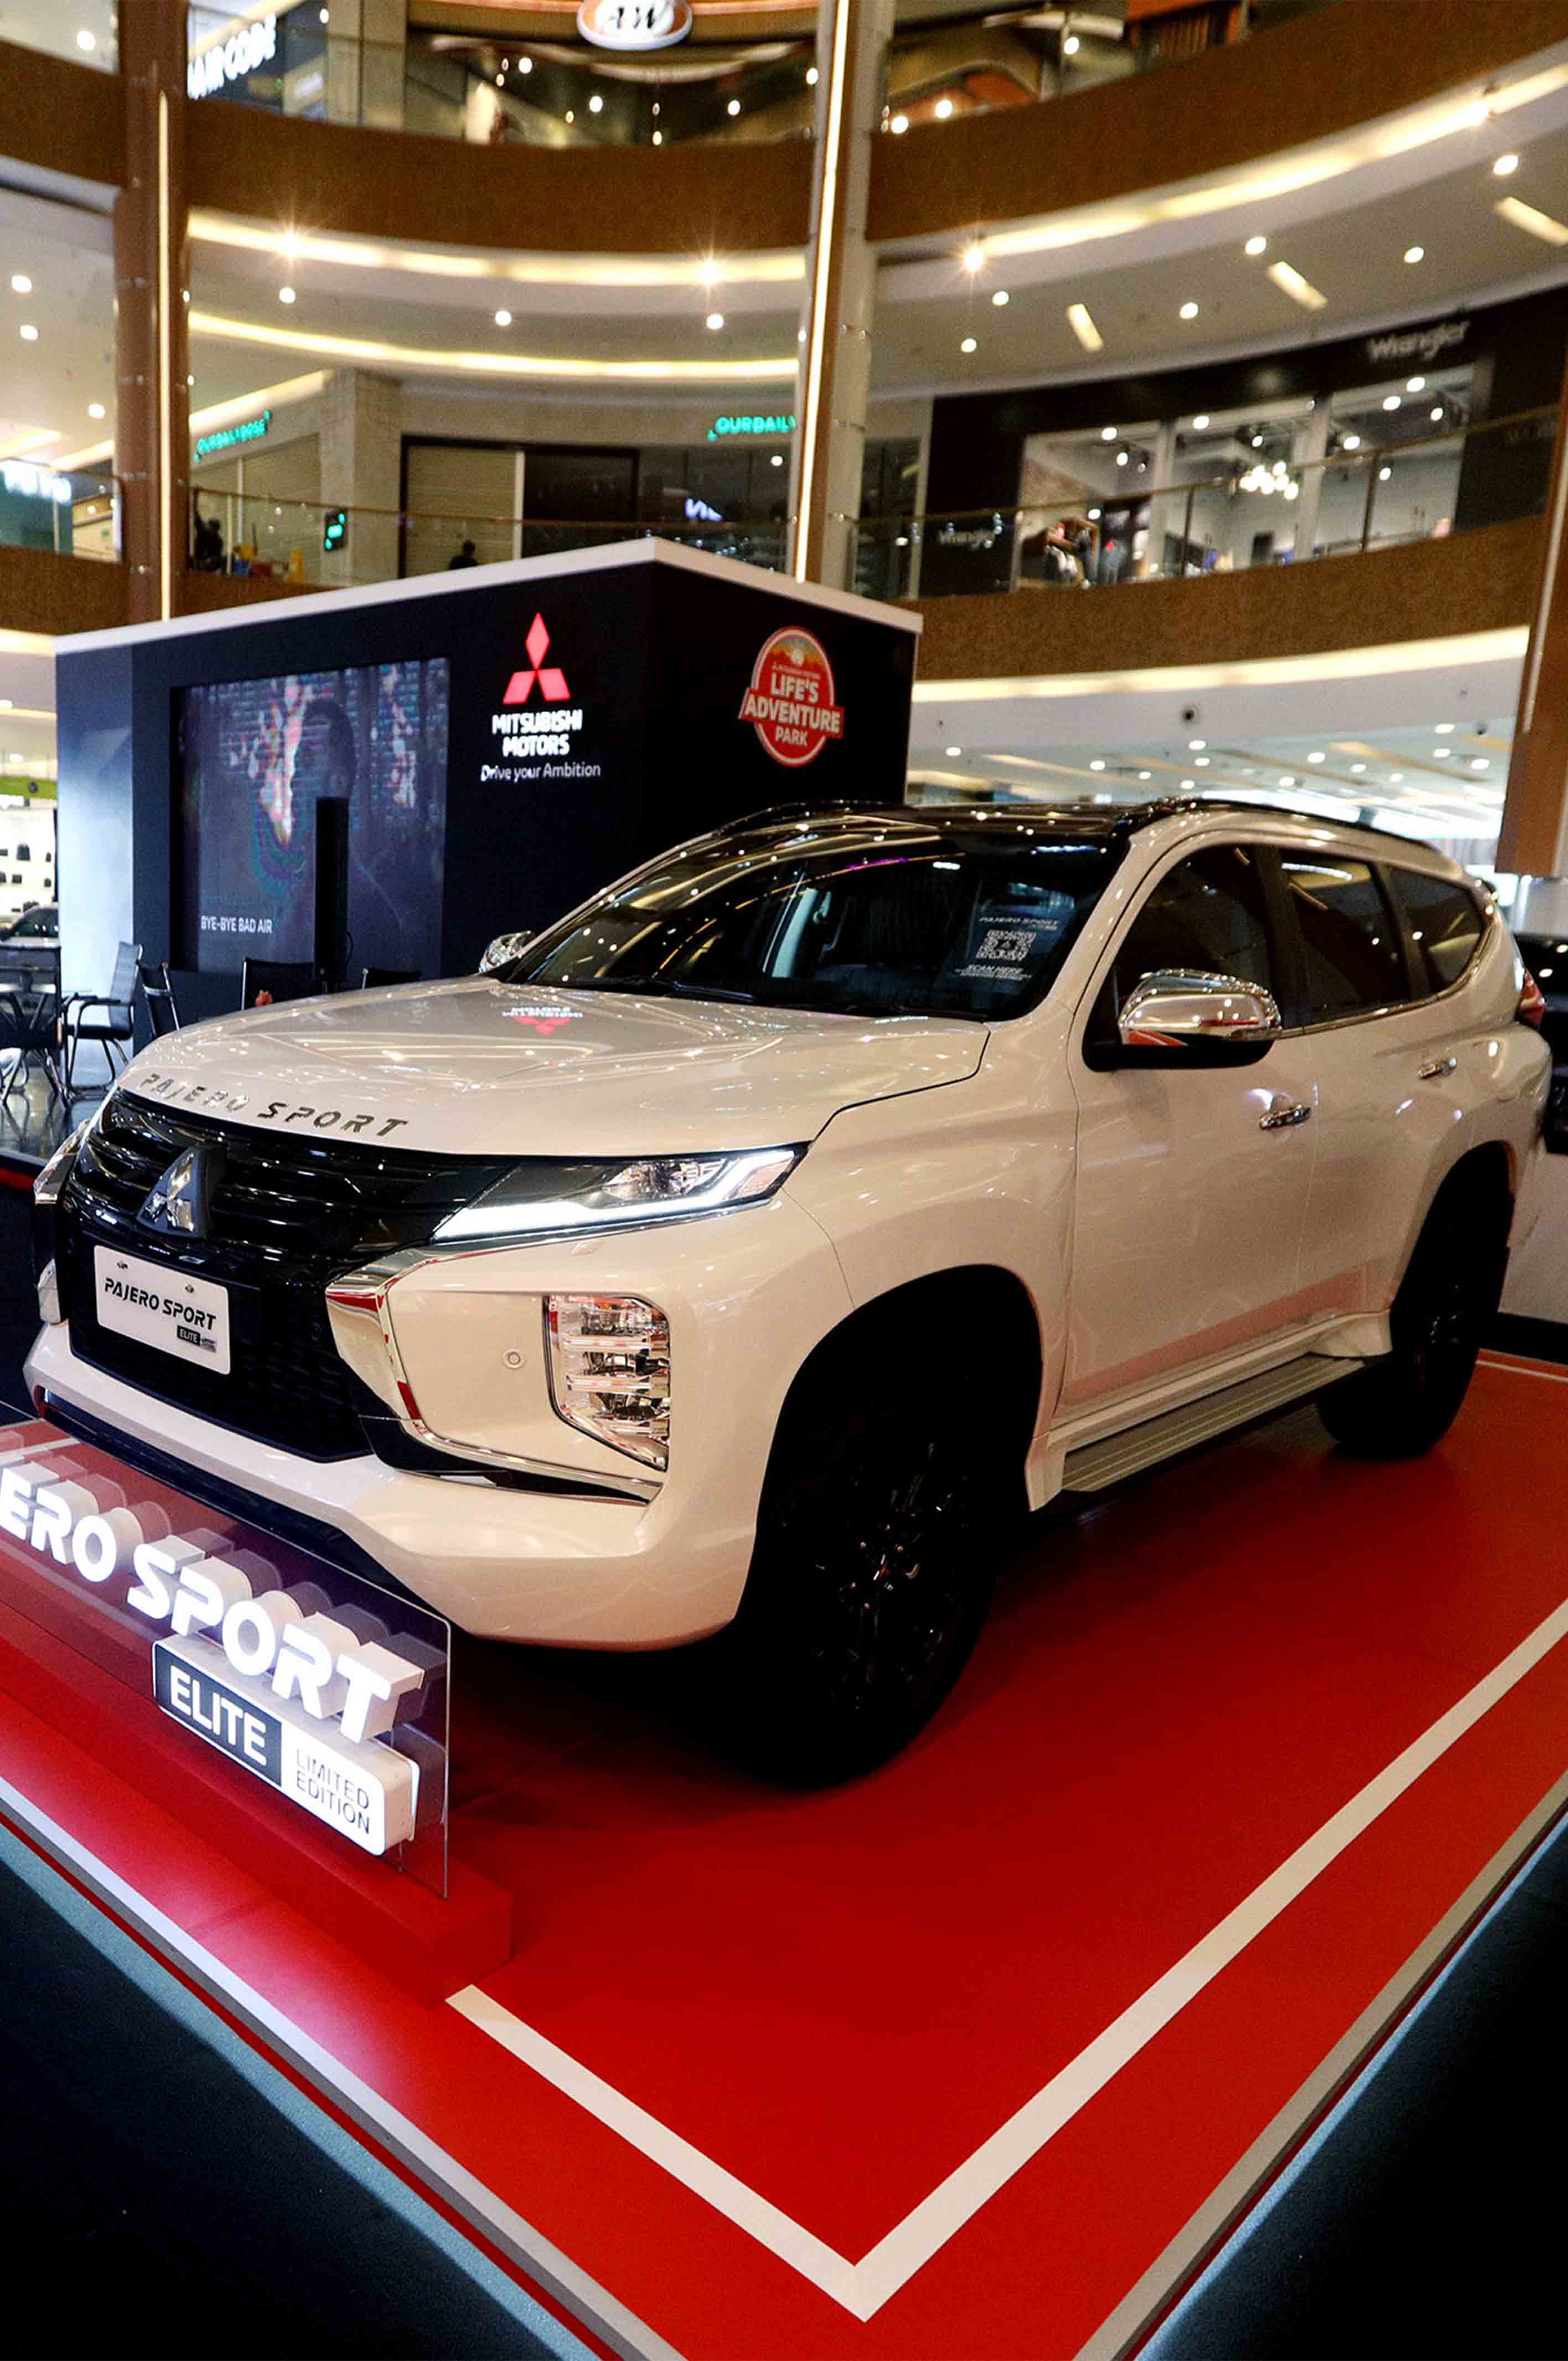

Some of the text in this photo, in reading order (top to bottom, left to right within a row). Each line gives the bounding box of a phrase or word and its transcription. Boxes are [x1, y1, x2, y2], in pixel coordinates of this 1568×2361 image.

[1367, 321, 1471, 363] Wrangler
[772, 672, 819, 703] LIFE'S
[491, 709, 583, 735] MITSUBISHI
[745, 693, 841, 734] ADVENTURE
[503, 733, 570, 758] MOTORS
[775, 725, 808, 747] PARK
[480, 761, 601, 783] Drive your Ambition
[200, 915, 273, 934] BYE-BYE BAD AIR
[141, 1073, 408, 1137] PAJERO SPORT
[105, 1277, 216, 1330] PAJERO SPORT
[179, 1329, 199, 1344] ELITE
[127, 1541, 390, 1745] SPORT
[169, 1664, 267, 1768] ELITE
[296, 1748, 370, 1810] LIMITED
[296, 1770, 370, 1835] EDITION
